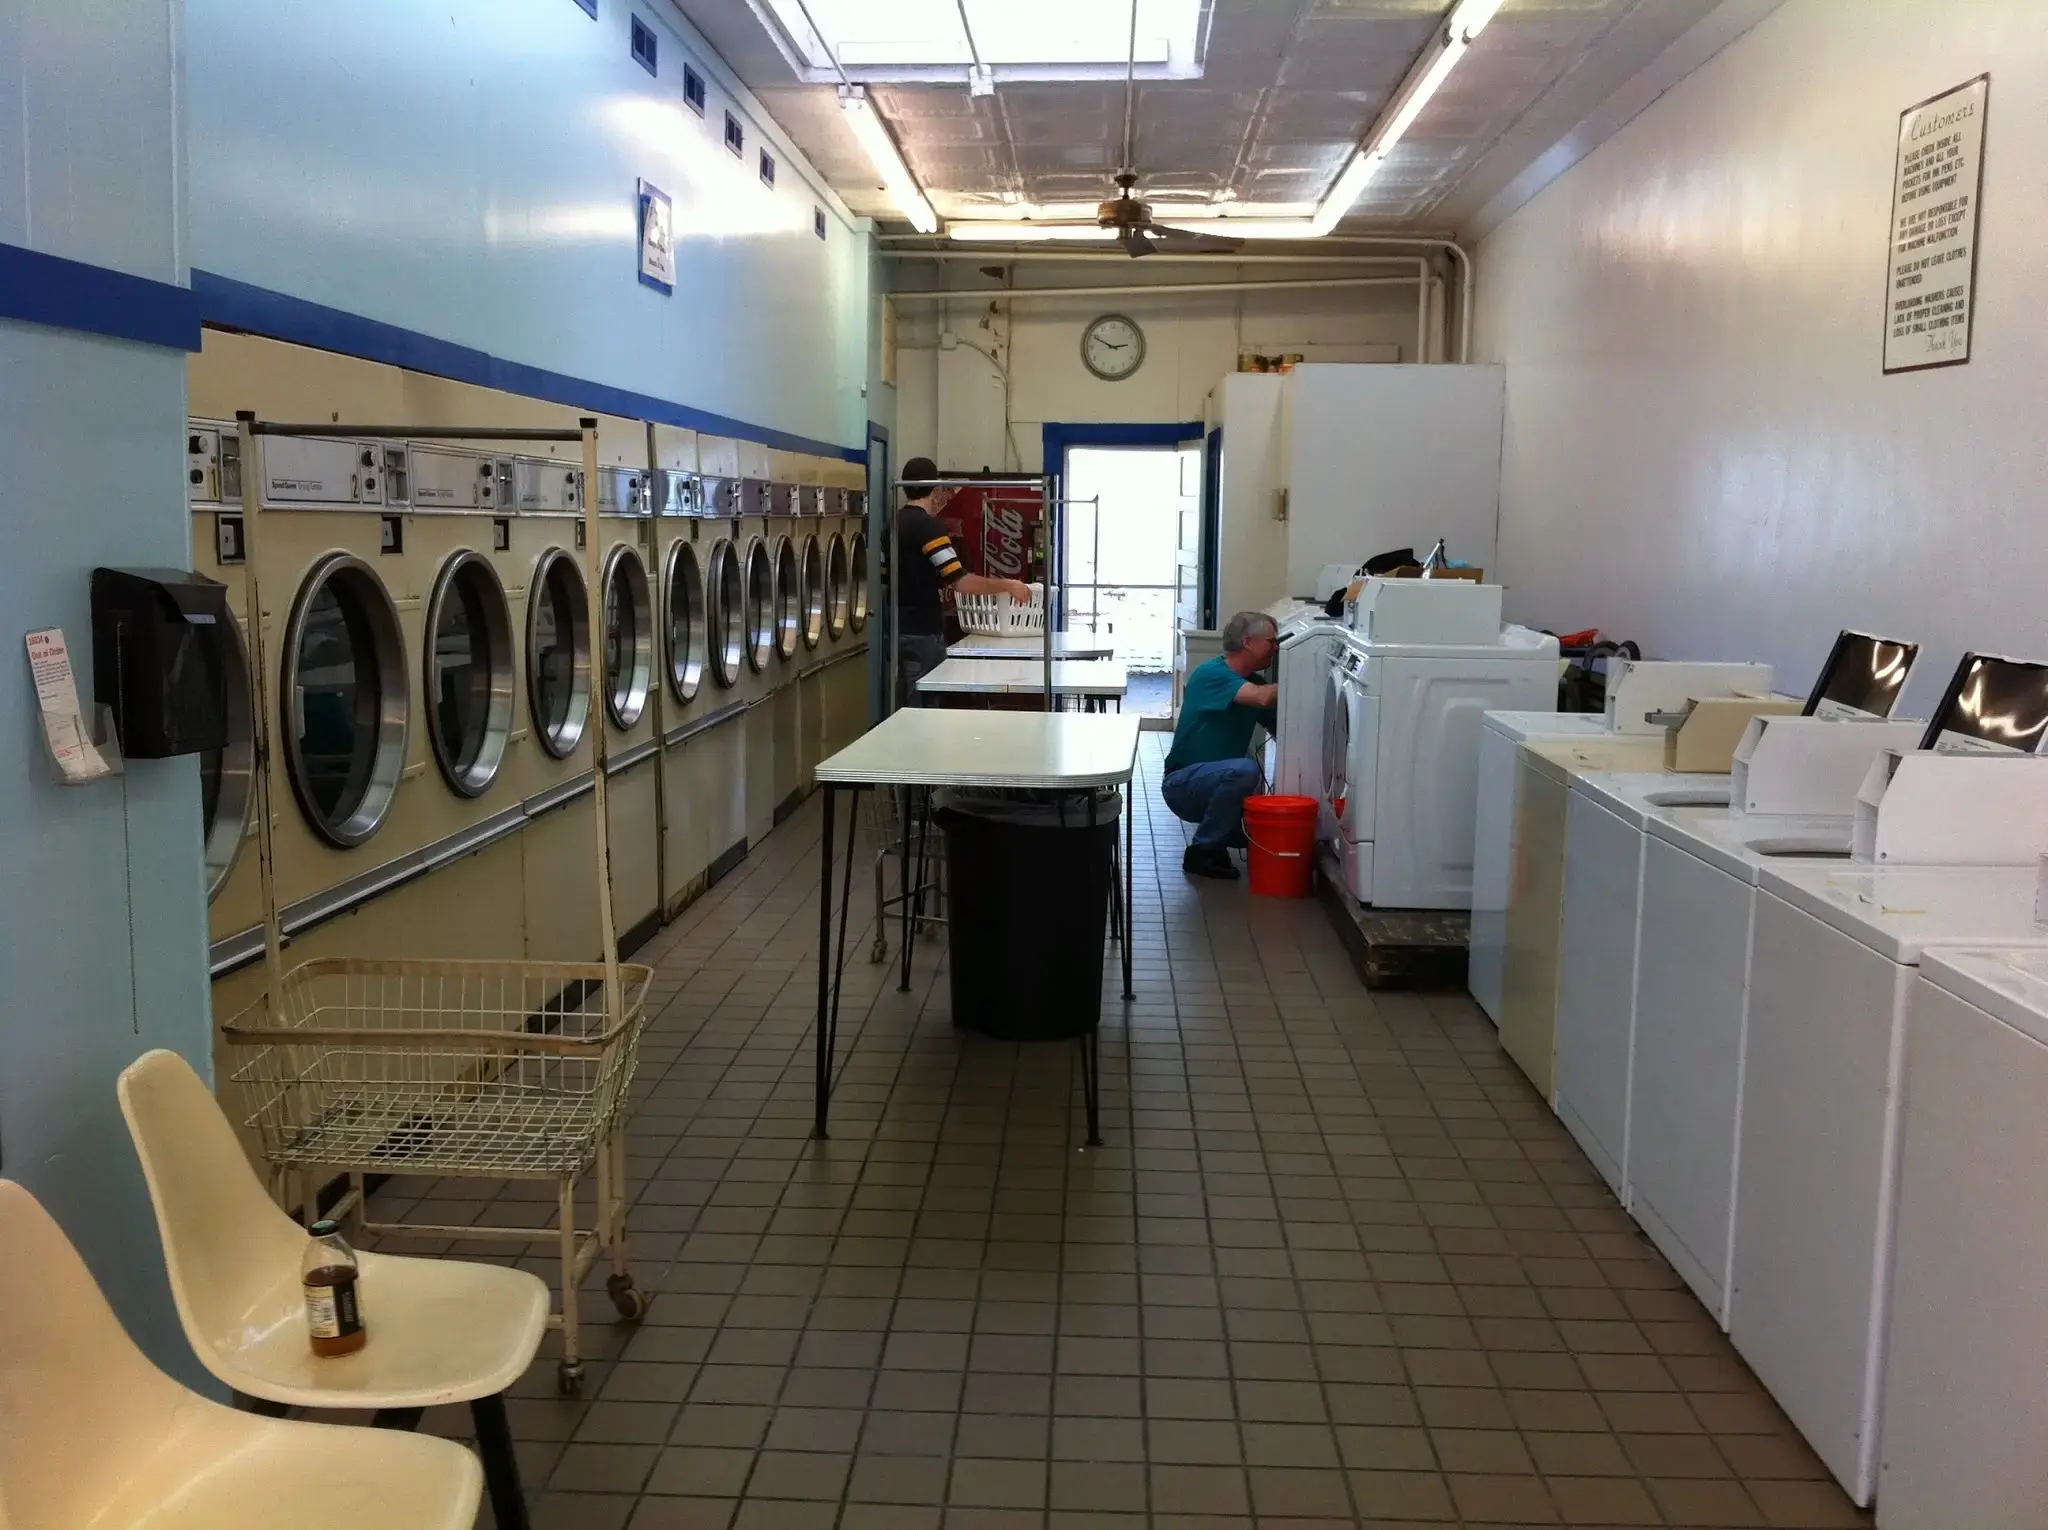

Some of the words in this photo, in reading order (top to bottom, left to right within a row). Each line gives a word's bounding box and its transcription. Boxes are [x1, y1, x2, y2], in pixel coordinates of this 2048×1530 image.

[1911, 103, 1974, 140] Customers
[1904, 149, 1920, 163] PLEASE
[1953, 131, 1962, 143] ALL
[1925, 156, 1935, 167] AND
[1936, 152, 1944, 163] ALL
[1947, 145, 1958, 158] YOUR
[1903, 175, 1921, 190] POCKETS
[1923, 171, 1931, 181] FOR
[1928, 199, 1957, 218] RESPONSIBLE
[1959, 196, 1968, 208] FOR
[1935, 215, 1947, 228] LOSS
[1907, 237, 1925, 250] MACHINE
[1927, 226, 1958, 244] MALFUNCTION
[1896, 263, 1912, 275] PLEASE
[1921, 256, 1930, 268] NOT
[1931, 252, 1945, 266] LEAVE
[1946, 247, 1967, 261] CLOTHES
[1924, 290, 1945, 303] WASHERS
[1946, 285, 1964, 298] CAUSES
[1894, 314, 1905, 324] LACK
[1931, 302, 1953, 316] CLEANING
[1955, 299, 1964, 310] AND
[1905, 325, 1911, 335] OF
[1912, 322, 1926, 333] SMALL
[1928, 317, 1949, 331] CLOTHING
[1951, 313, 1964, 325] ITEMS
[1926, 328, 1946, 352] Thank
[351, 474, 359, 498] 2
